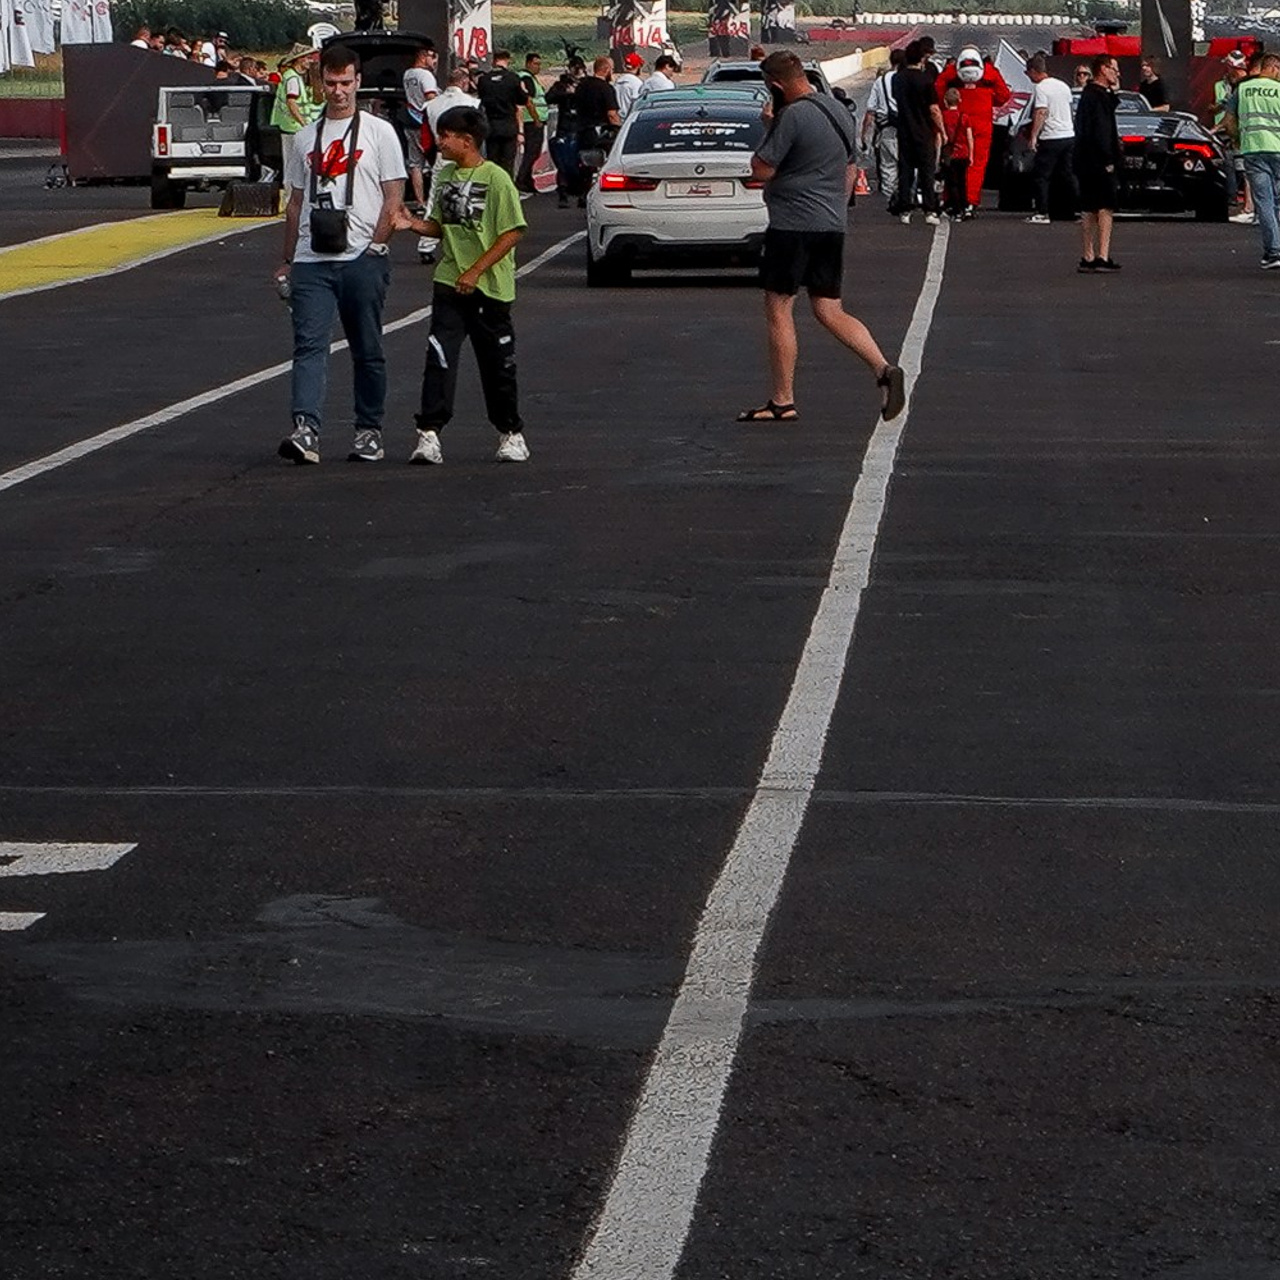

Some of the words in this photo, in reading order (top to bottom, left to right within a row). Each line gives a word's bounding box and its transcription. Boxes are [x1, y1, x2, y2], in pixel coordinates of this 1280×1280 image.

[453, 26, 488, 61] 1/8
[637, 26, 662, 48] 1/4
[1245, 86, 1279, 99] ПРЕССА
